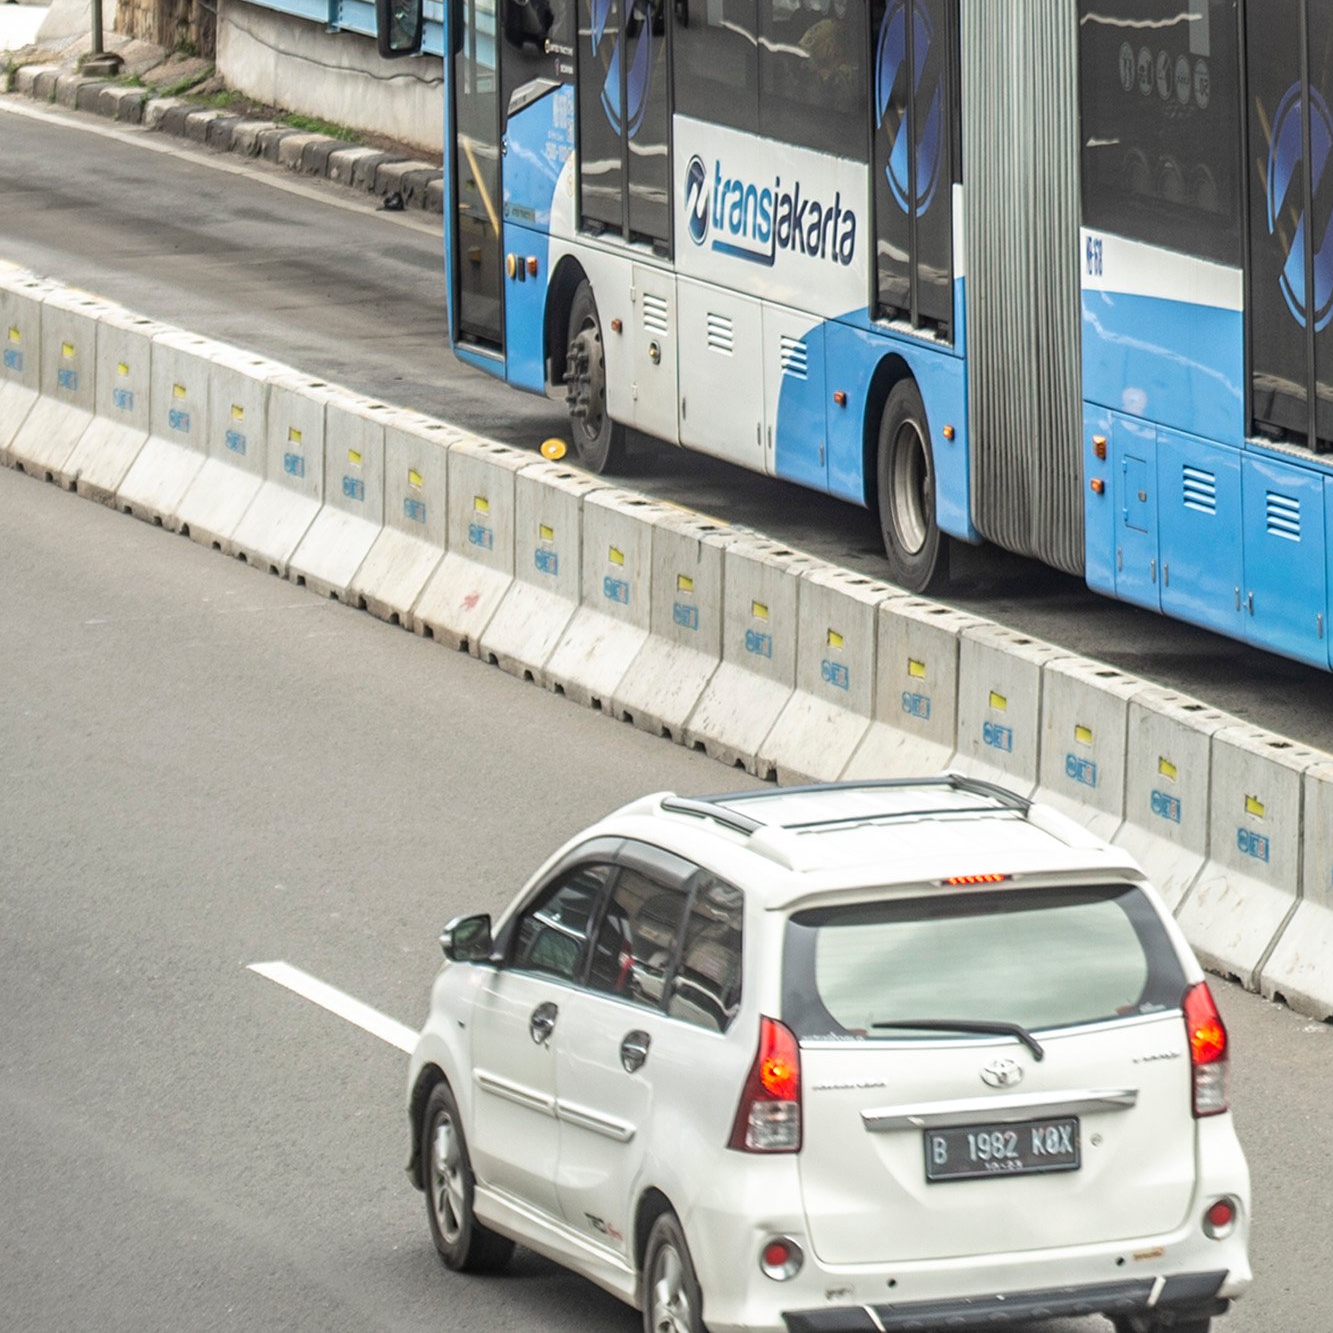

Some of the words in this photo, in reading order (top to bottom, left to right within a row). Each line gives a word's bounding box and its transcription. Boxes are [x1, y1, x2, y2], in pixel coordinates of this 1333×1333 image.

[712, 160, 857, 267] transjakarta
[933, 1137, 948, 1164] B
[967, 1130, 1018, 1161] 1982
